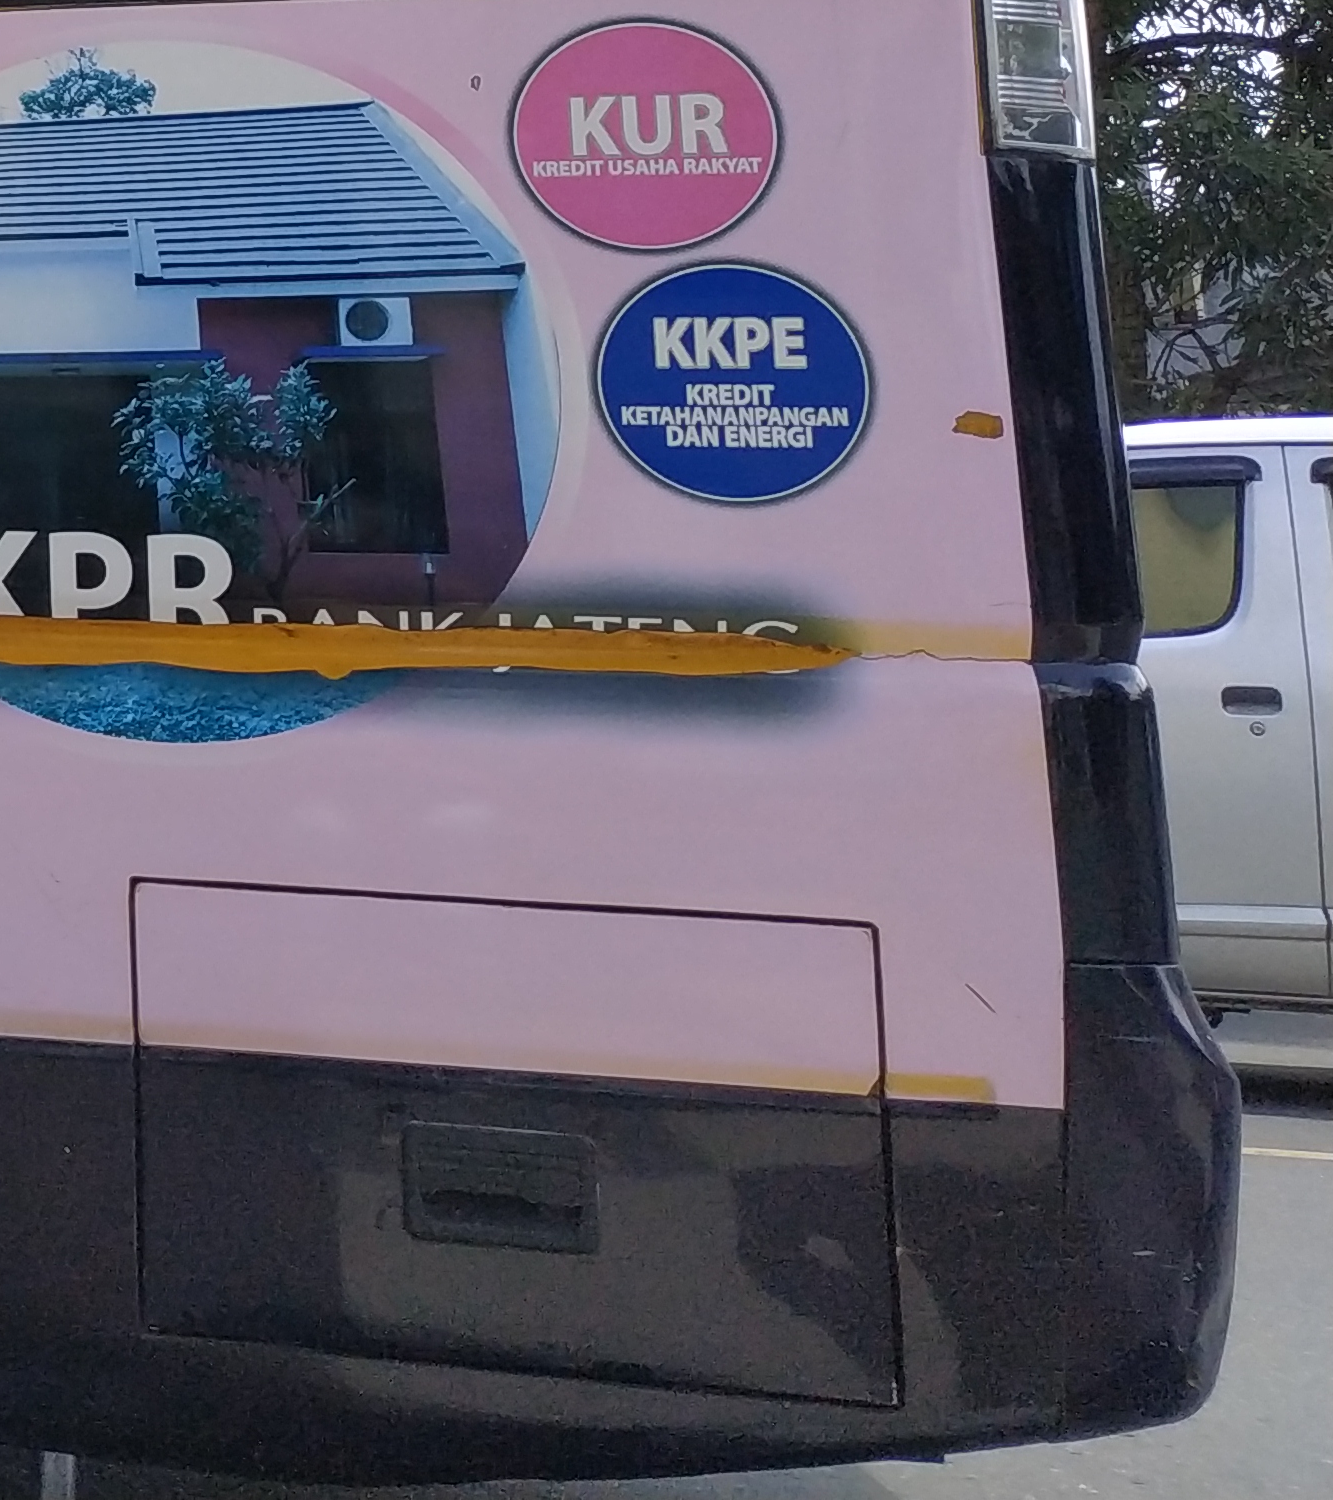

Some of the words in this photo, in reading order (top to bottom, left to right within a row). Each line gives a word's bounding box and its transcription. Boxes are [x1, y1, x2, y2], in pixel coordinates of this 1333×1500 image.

[569, 93, 728, 157] KUR
[533, 160, 604, 177] KREDIT
[608, 158, 680, 176] USAHA
[683, 156, 763, 175] RAKYAT
[653, 316, 808, 370] KKPE
[685, 384, 775, 406] KREDIT
[620, 405, 850, 427] KETAHANANPANGAN
[666, 425, 720, 448] DAN
[724, 426, 814, 448] ENERGI
